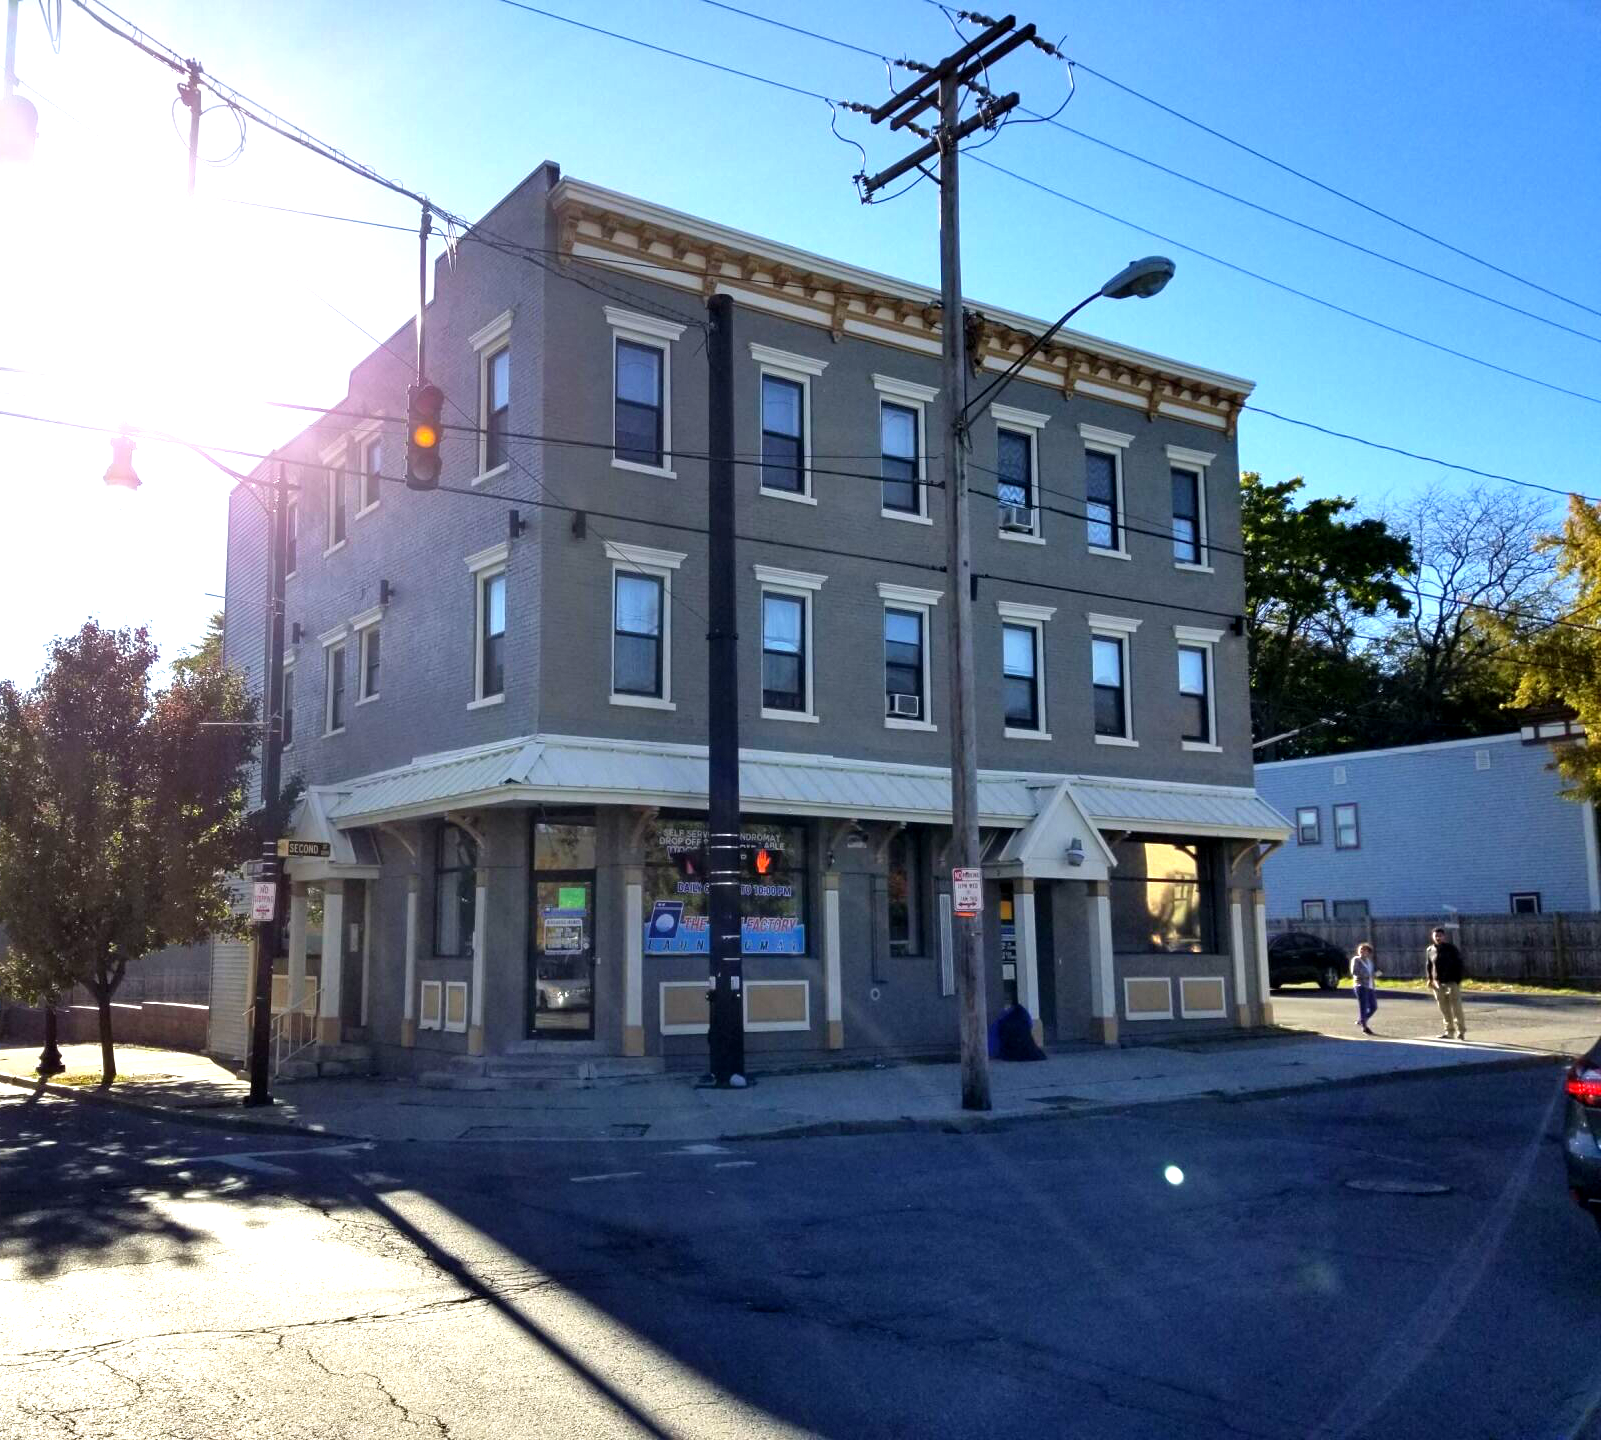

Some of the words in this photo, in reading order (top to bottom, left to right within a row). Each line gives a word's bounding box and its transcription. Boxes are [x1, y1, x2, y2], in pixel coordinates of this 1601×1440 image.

[663, 828, 685, 837] SELF
[659, 836, 684, 846] DROP
[685, 838, 702, 847] OFF
[289, 843, 318, 855] SECOND
[677, 881, 703, 894] DAILY
[777, 885, 792, 897] PM
[684, 915, 709, 933] THE
[746, 917, 798, 933] FACTORY
